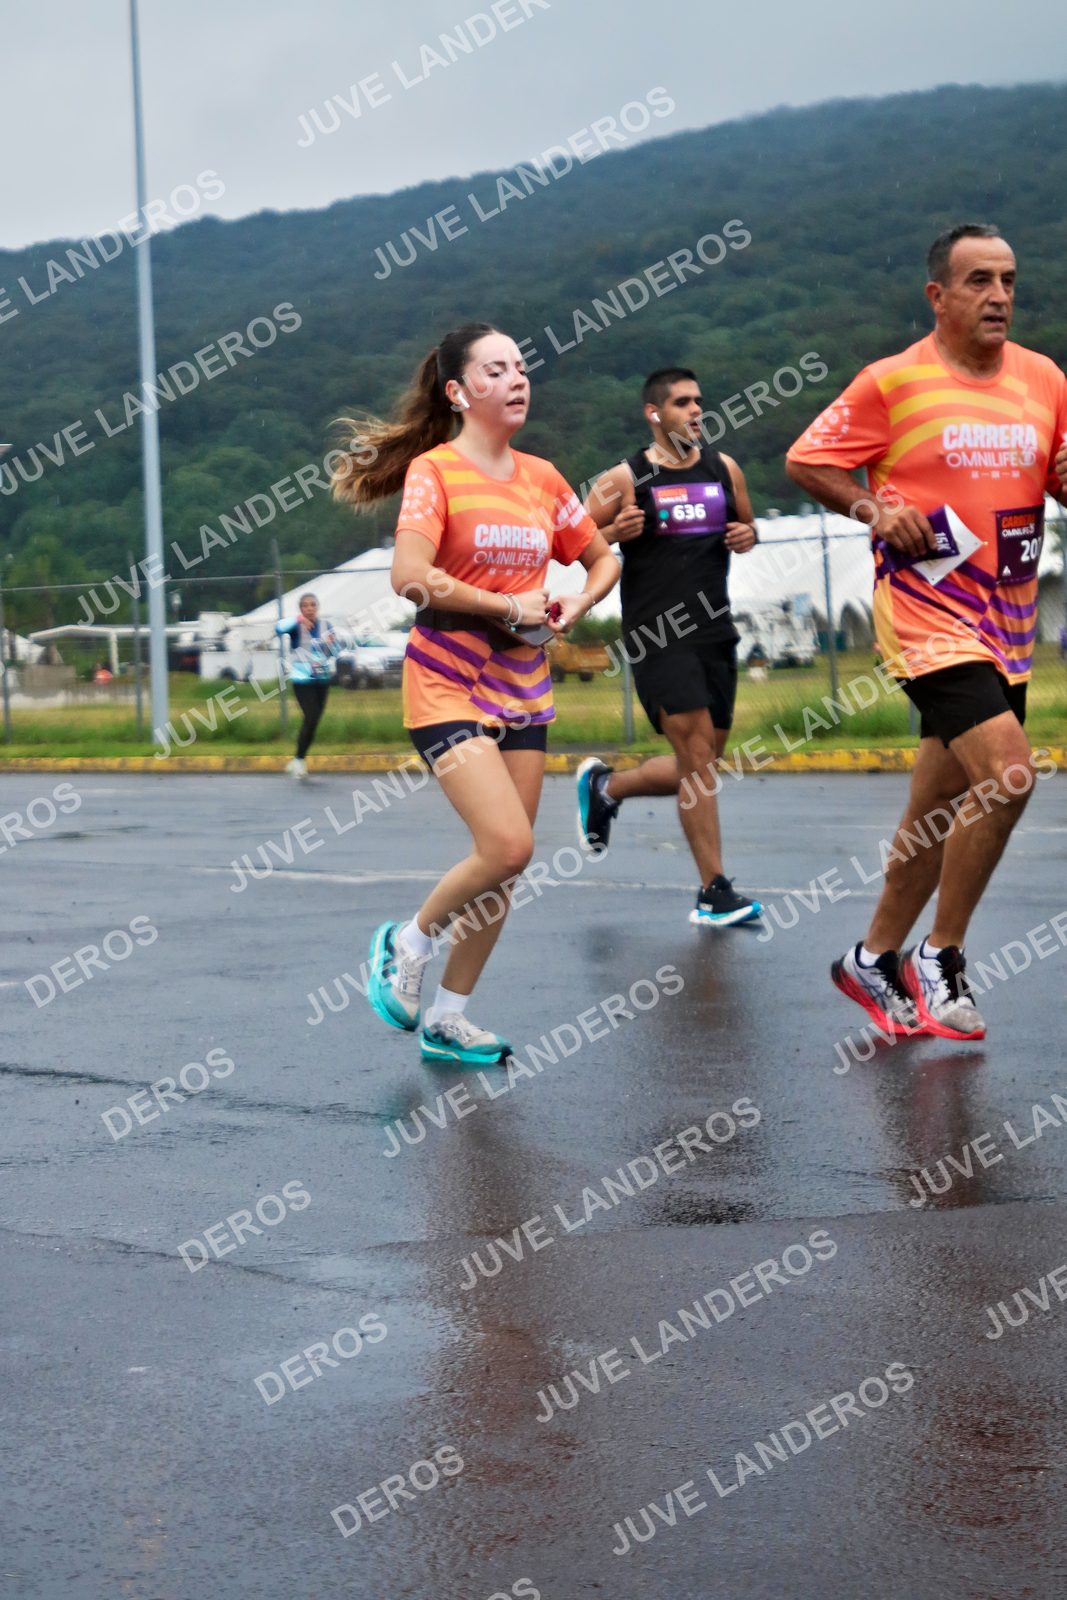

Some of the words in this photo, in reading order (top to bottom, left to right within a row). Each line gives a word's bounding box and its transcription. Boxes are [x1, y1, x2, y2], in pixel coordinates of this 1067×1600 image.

[942, 422, 1037, 450] CARRERA
[945, 451, 1018, 468] OMNILIFE
[673, 503, 706, 521] 636
[474, 524, 548, 550] CARRERA
[473, 550, 532, 567] OMNILIFE
